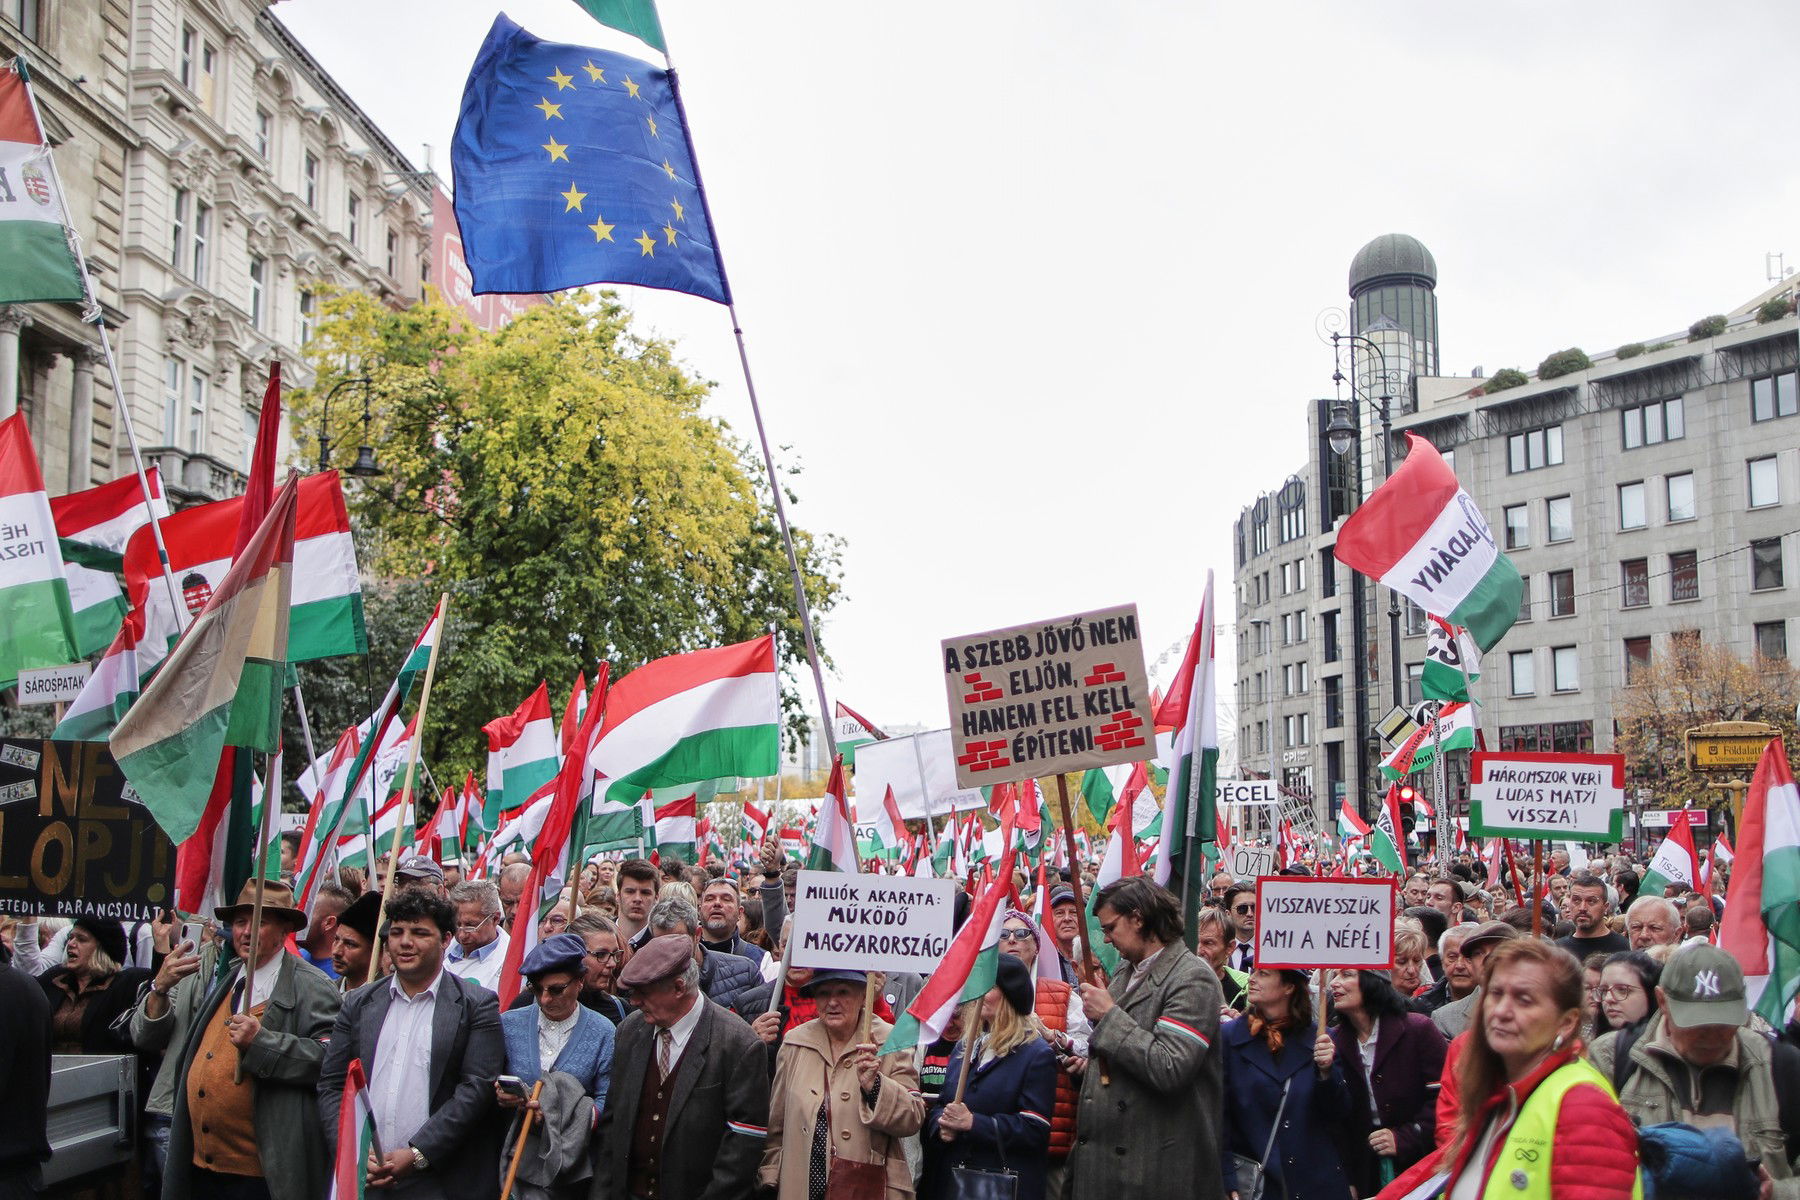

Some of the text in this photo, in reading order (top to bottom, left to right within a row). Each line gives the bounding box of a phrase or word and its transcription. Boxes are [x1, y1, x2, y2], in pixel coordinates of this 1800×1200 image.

[945, 615, 1138, 674] A SZEBB JÖVŐ NEM
[25, 675, 85, 694] SÁROSPATAK
[1009, 660, 1078, 696] ELJÖN,
[962, 685, 1136, 737] HANEM FEL KELL
[1012, 726, 1094, 763] ÉPÍTENI
[1283, 752, 1297, 762] CPI
[40, 741, 130, 817] NE
[1488, 766, 1568, 784] HÁROMSZOR
[1496, 788, 1544, 802] LUDAS
[805, 884, 941, 906] MILLIÓK AKARATA:
[1266, 896, 1381, 915] VISSZAVESSZÜK
[57, 899, 162, 921] PARANCSOLAT
[827, 903, 909, 926] MŰKÖDŐ
[804, 932, 948, 958] MAGYARORSZÁG!
[1262, 923, 1381, 954] AMI A NÉPÉ!
